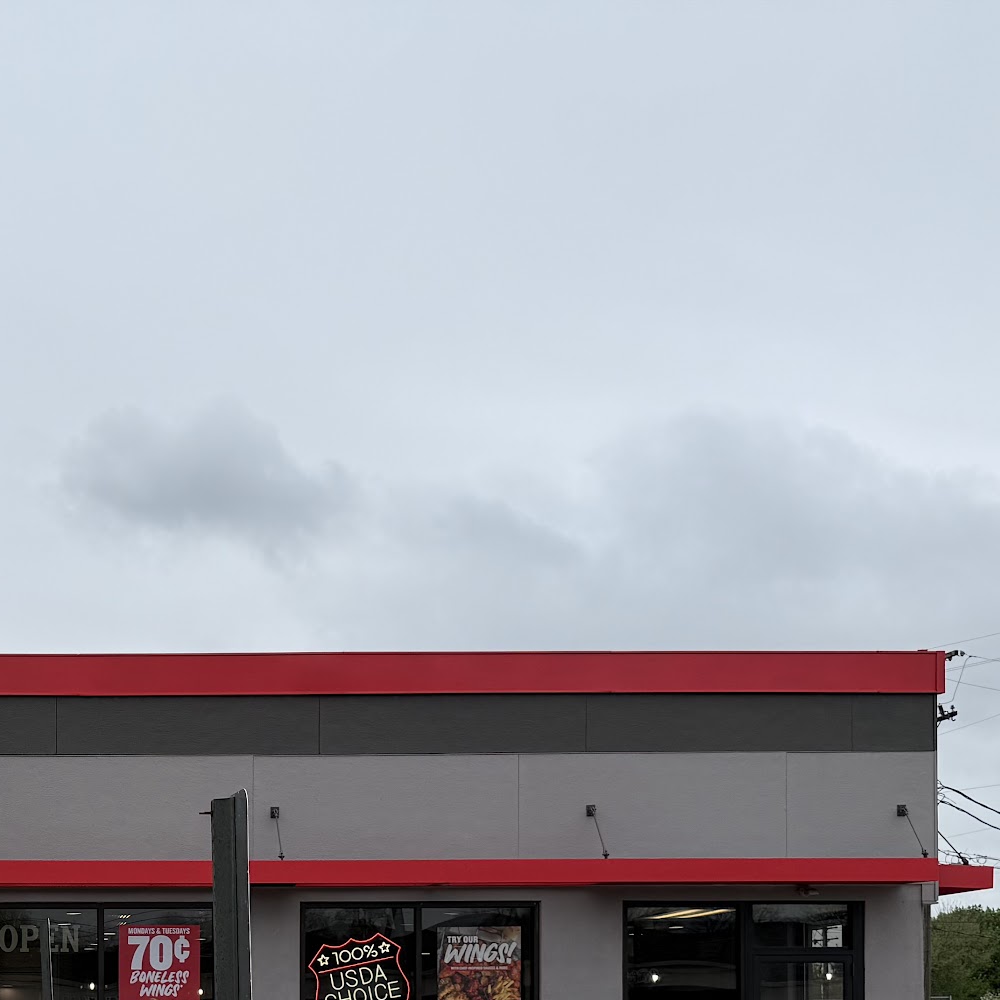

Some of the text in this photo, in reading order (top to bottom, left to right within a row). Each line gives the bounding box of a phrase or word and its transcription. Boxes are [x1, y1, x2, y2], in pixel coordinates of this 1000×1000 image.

[447, 935, 479, 944] TRY OUR
[127, 935, 191, 971] 70¢
[331, 943, 379, 965] 100%
[443, 942, 518, 965] WINGS!
[129, 970, 190, 984] BONELESS
[329, 964, 388, 991] USDA
